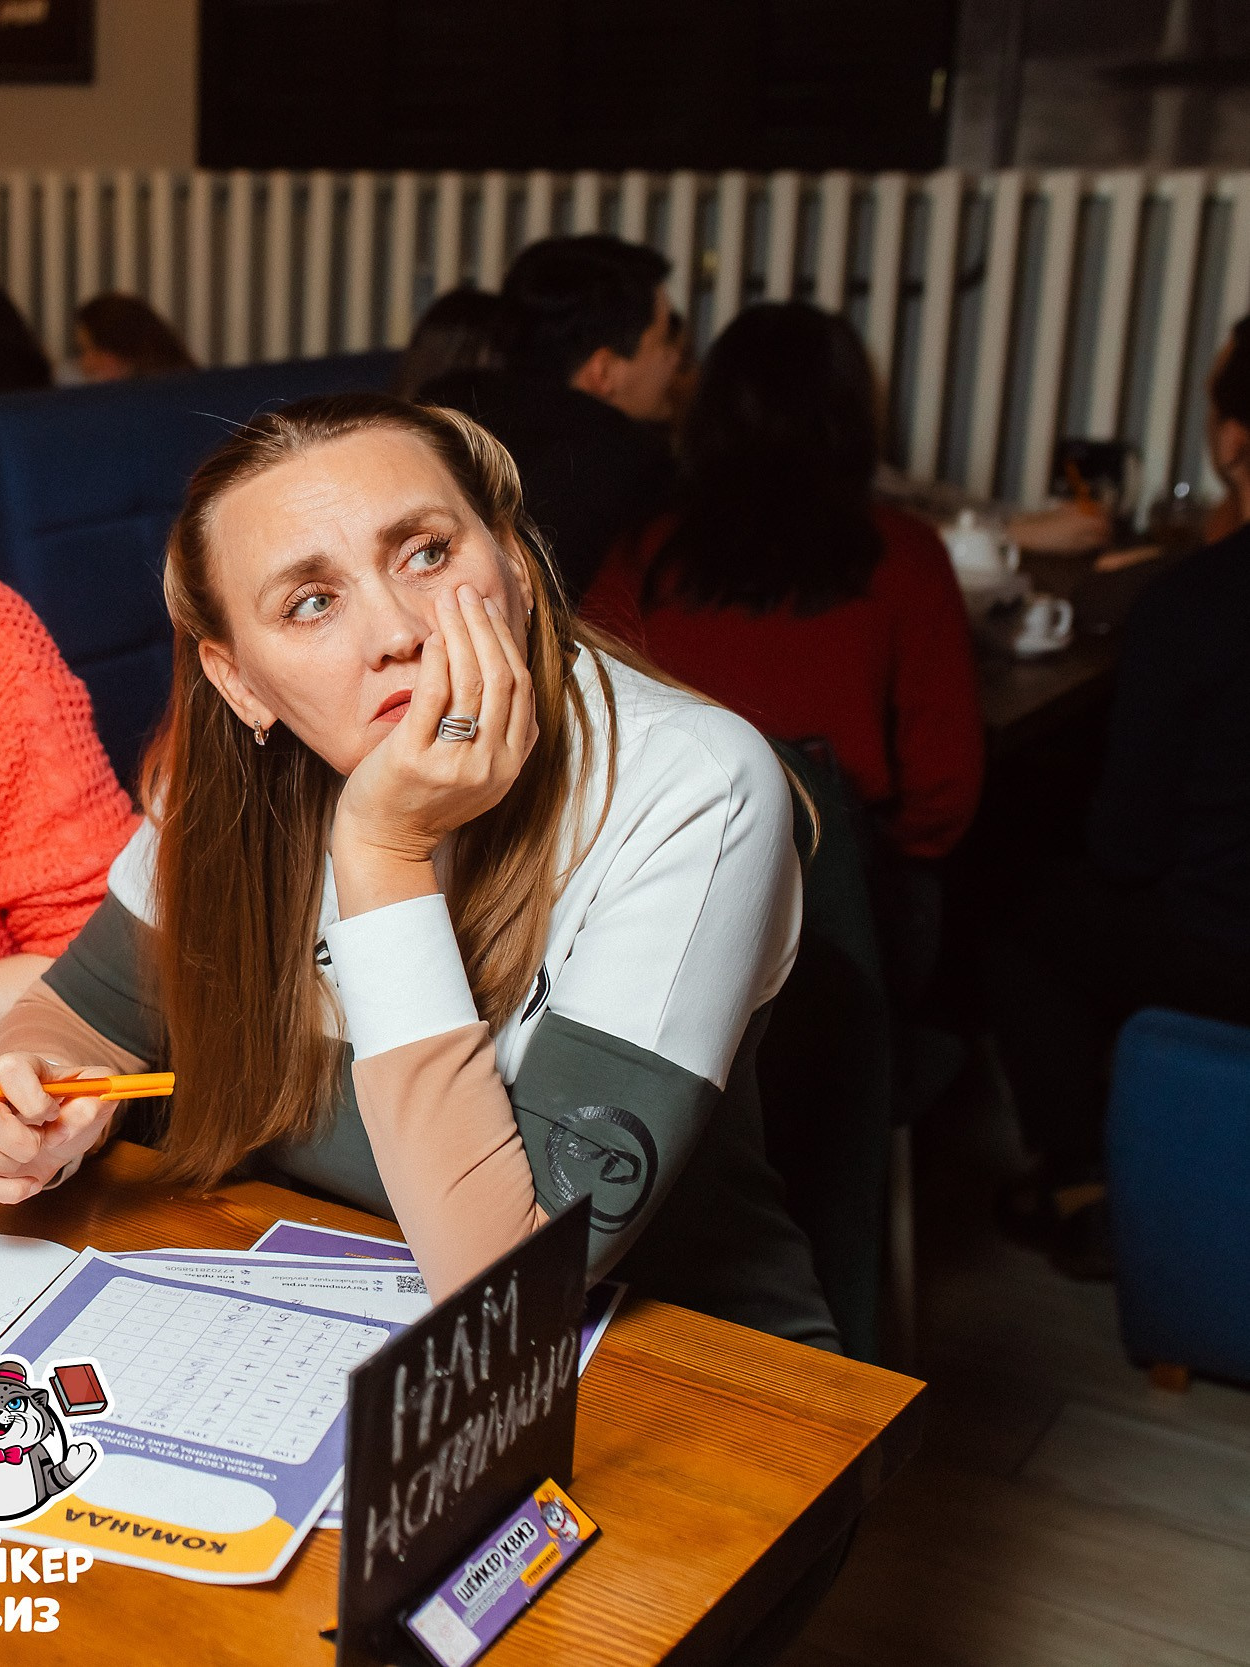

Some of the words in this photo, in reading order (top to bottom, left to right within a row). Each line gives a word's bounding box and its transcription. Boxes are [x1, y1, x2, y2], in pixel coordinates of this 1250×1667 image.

[391, 1268, 518, 1464] НАМ
[120, 1431, 148, 1443] ЕСЛИ
[147, 1436, 180, 1450] ДАЖЕ
[65, 1508, 228, 1554] КОМАНДА
[456, 1552, 502, 1602] ШЕЙКЕР
[500, 1521, 535, 1557] КВИЗ
